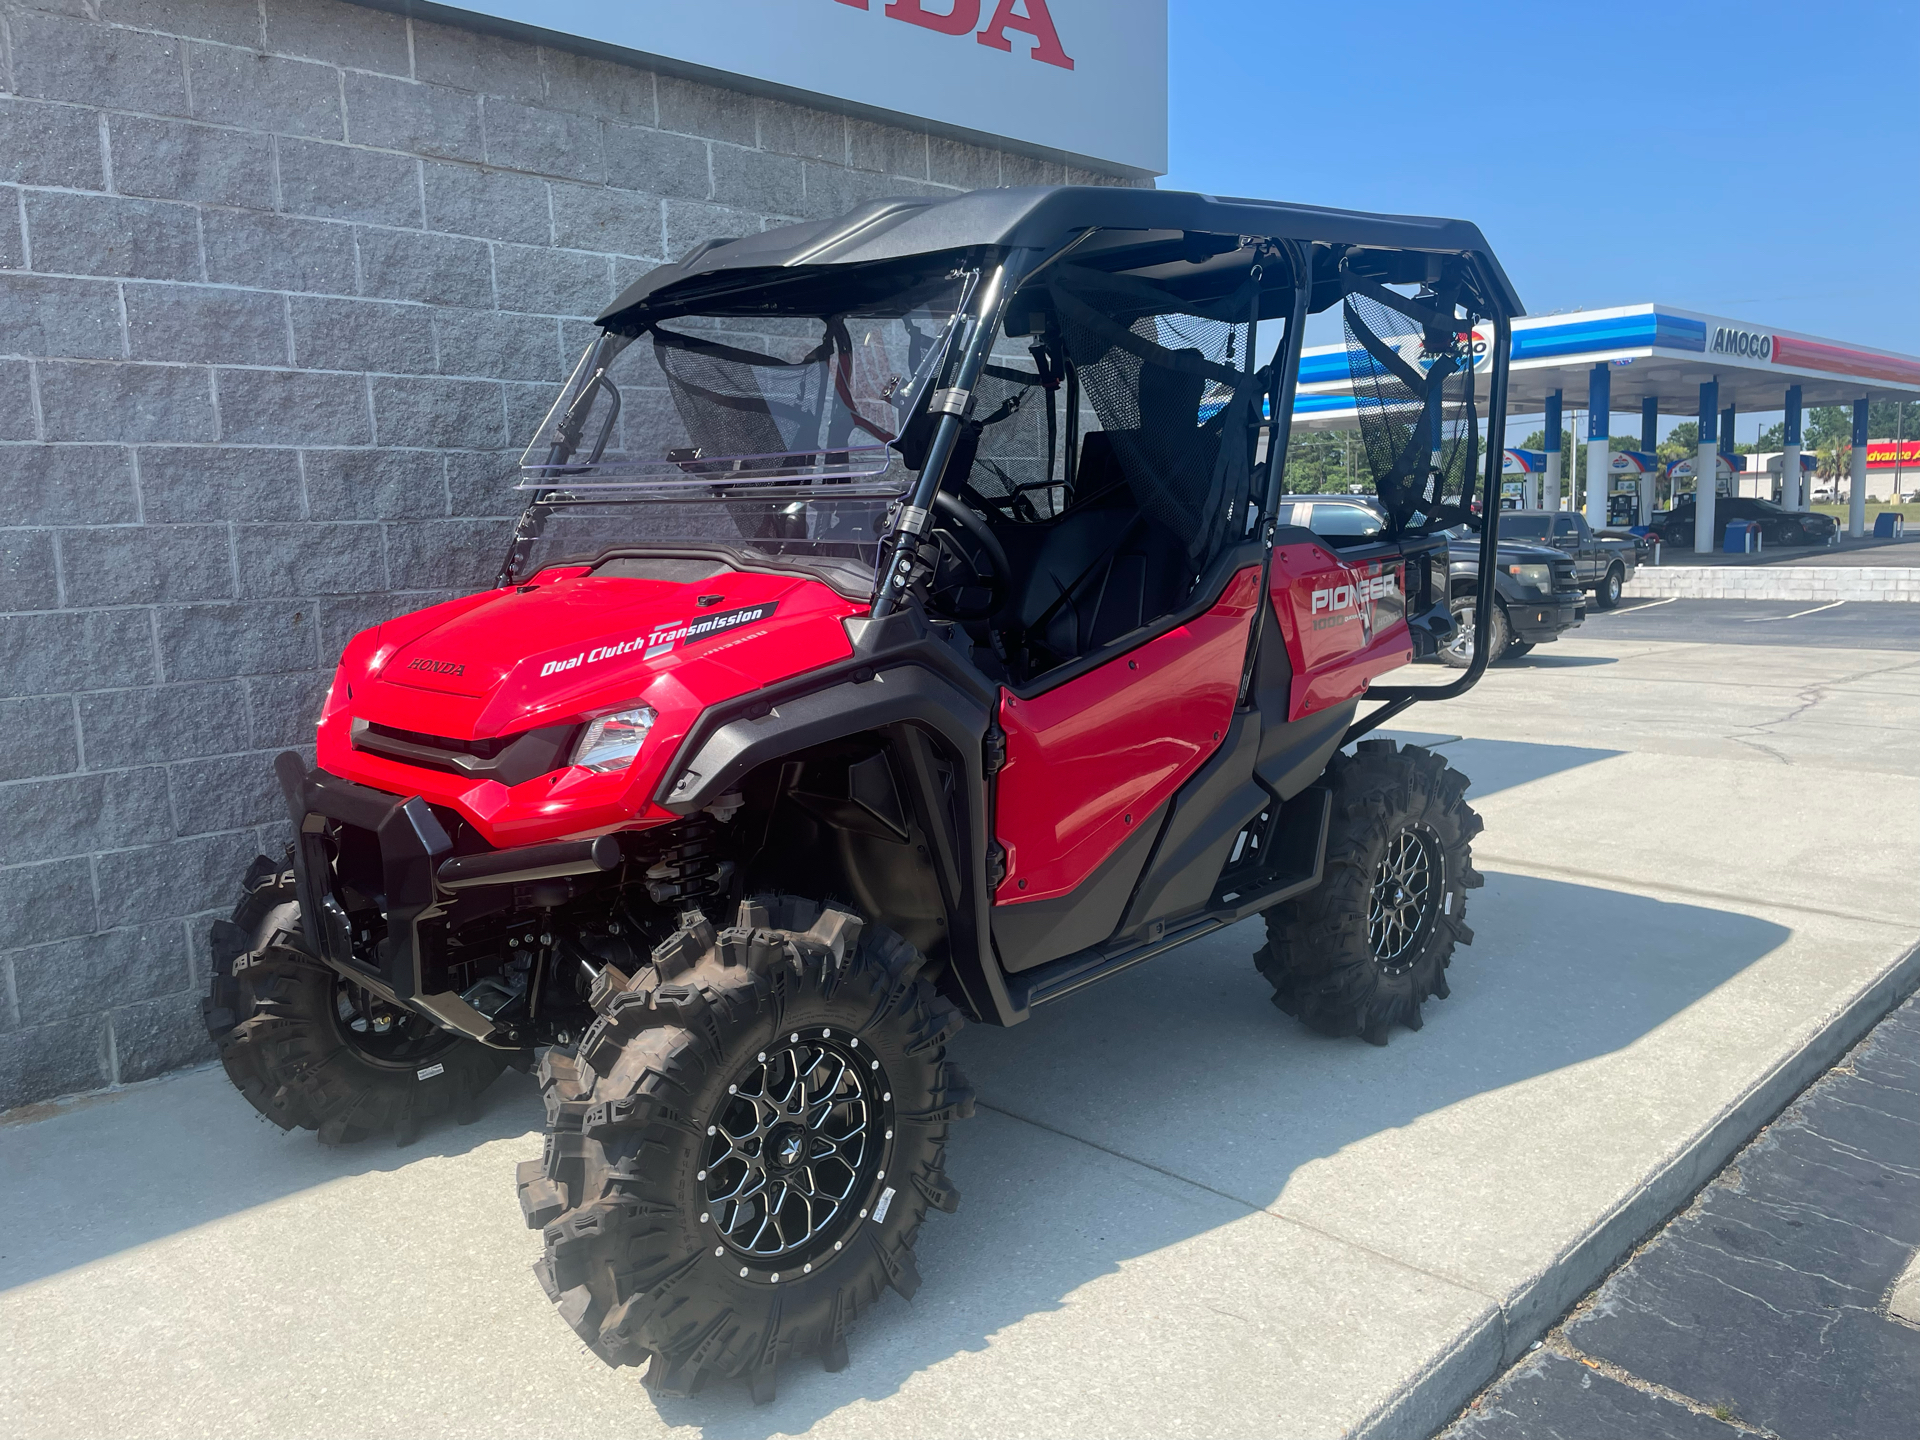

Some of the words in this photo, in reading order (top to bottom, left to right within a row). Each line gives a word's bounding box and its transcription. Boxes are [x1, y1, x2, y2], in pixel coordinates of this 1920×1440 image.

[1711, 327, 1770, 359] AMOCO
[1866, 450, 1911, 462] dvance
[1311, 574, 1395, 615] PIONEER
[1313, 614, 1344, 631] 1000
[540, 652, 584, 677] Dual
[587, 637, 644, 664] Clutch
[648, 607, 763, 647] Transmission
[407, 658, 466, 677] HONDA
